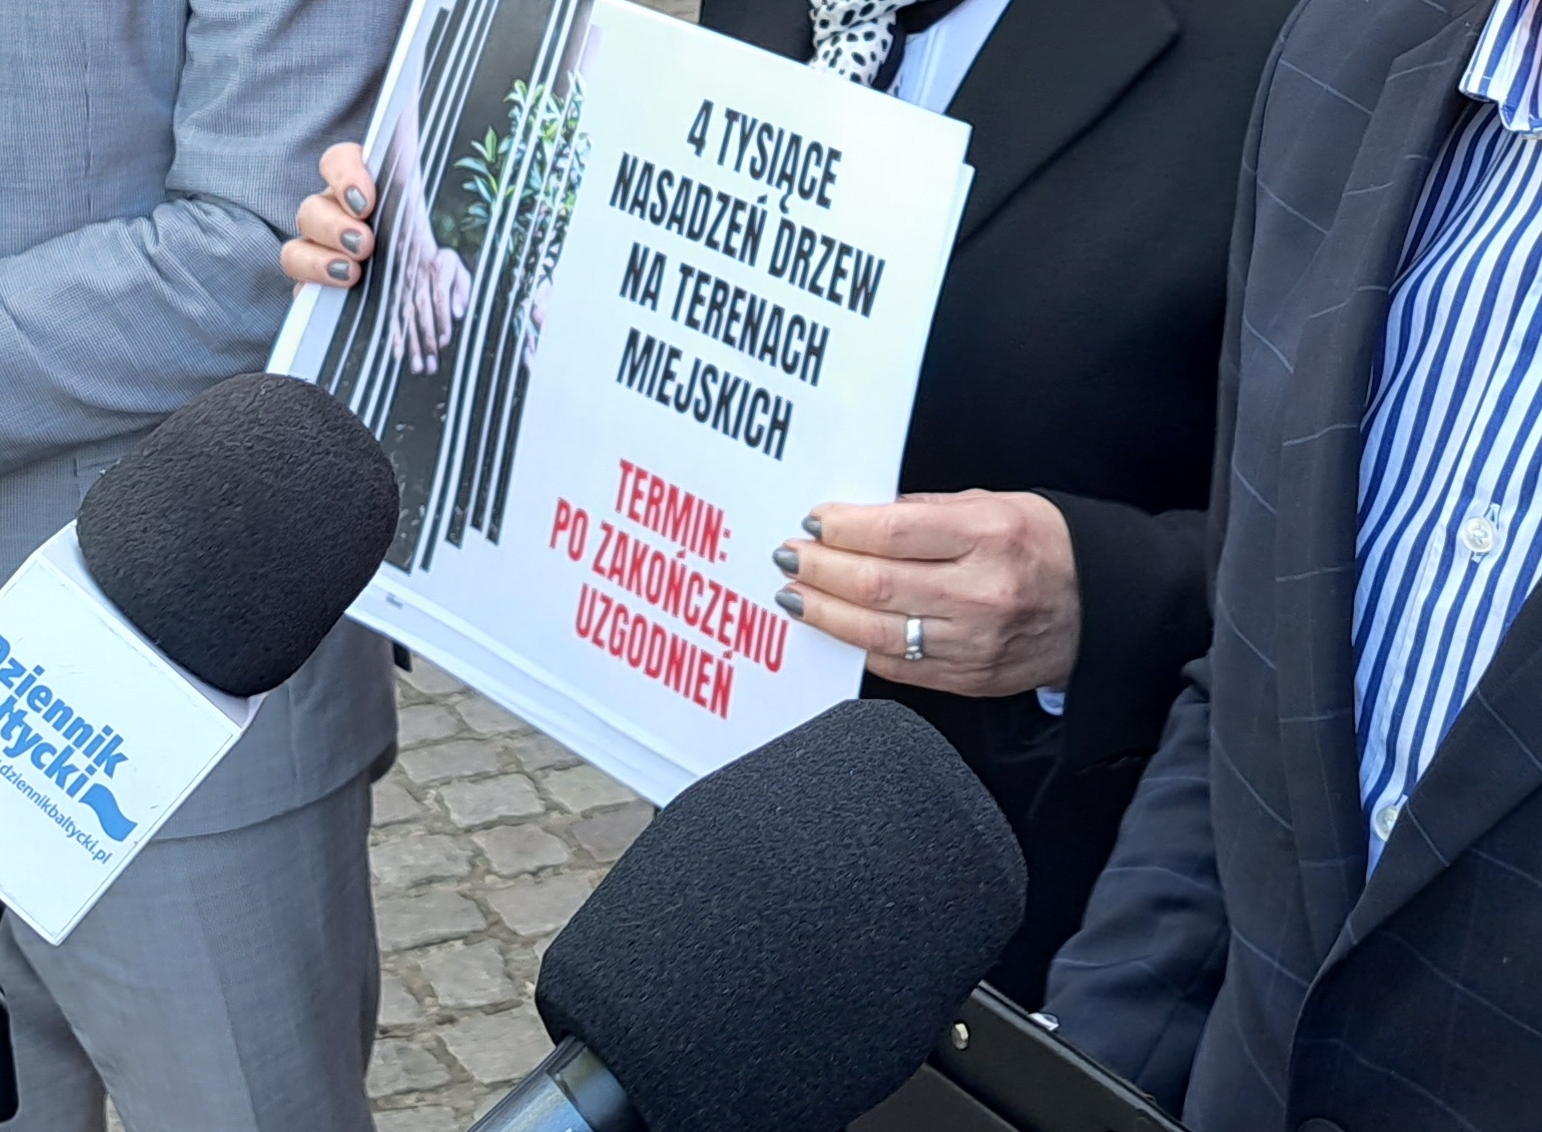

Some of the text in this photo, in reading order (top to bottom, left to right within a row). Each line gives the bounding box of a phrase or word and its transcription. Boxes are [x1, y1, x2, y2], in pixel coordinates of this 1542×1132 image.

[686, 98, 843, 215] 4 TYSIĄCE
[608, 151, 886, 319] NASADZEŃ DRZEW
[618, 241, 831, 388] NA TERENACH
[615, 325, 794, 461] MIEJSKICH
[614, 457, 732, 564] TERMIN:
[548, 496, 790, 674] PO ZAKOŃCZENIU
[575, 582, 735, 721] UZGODNIEŃ
